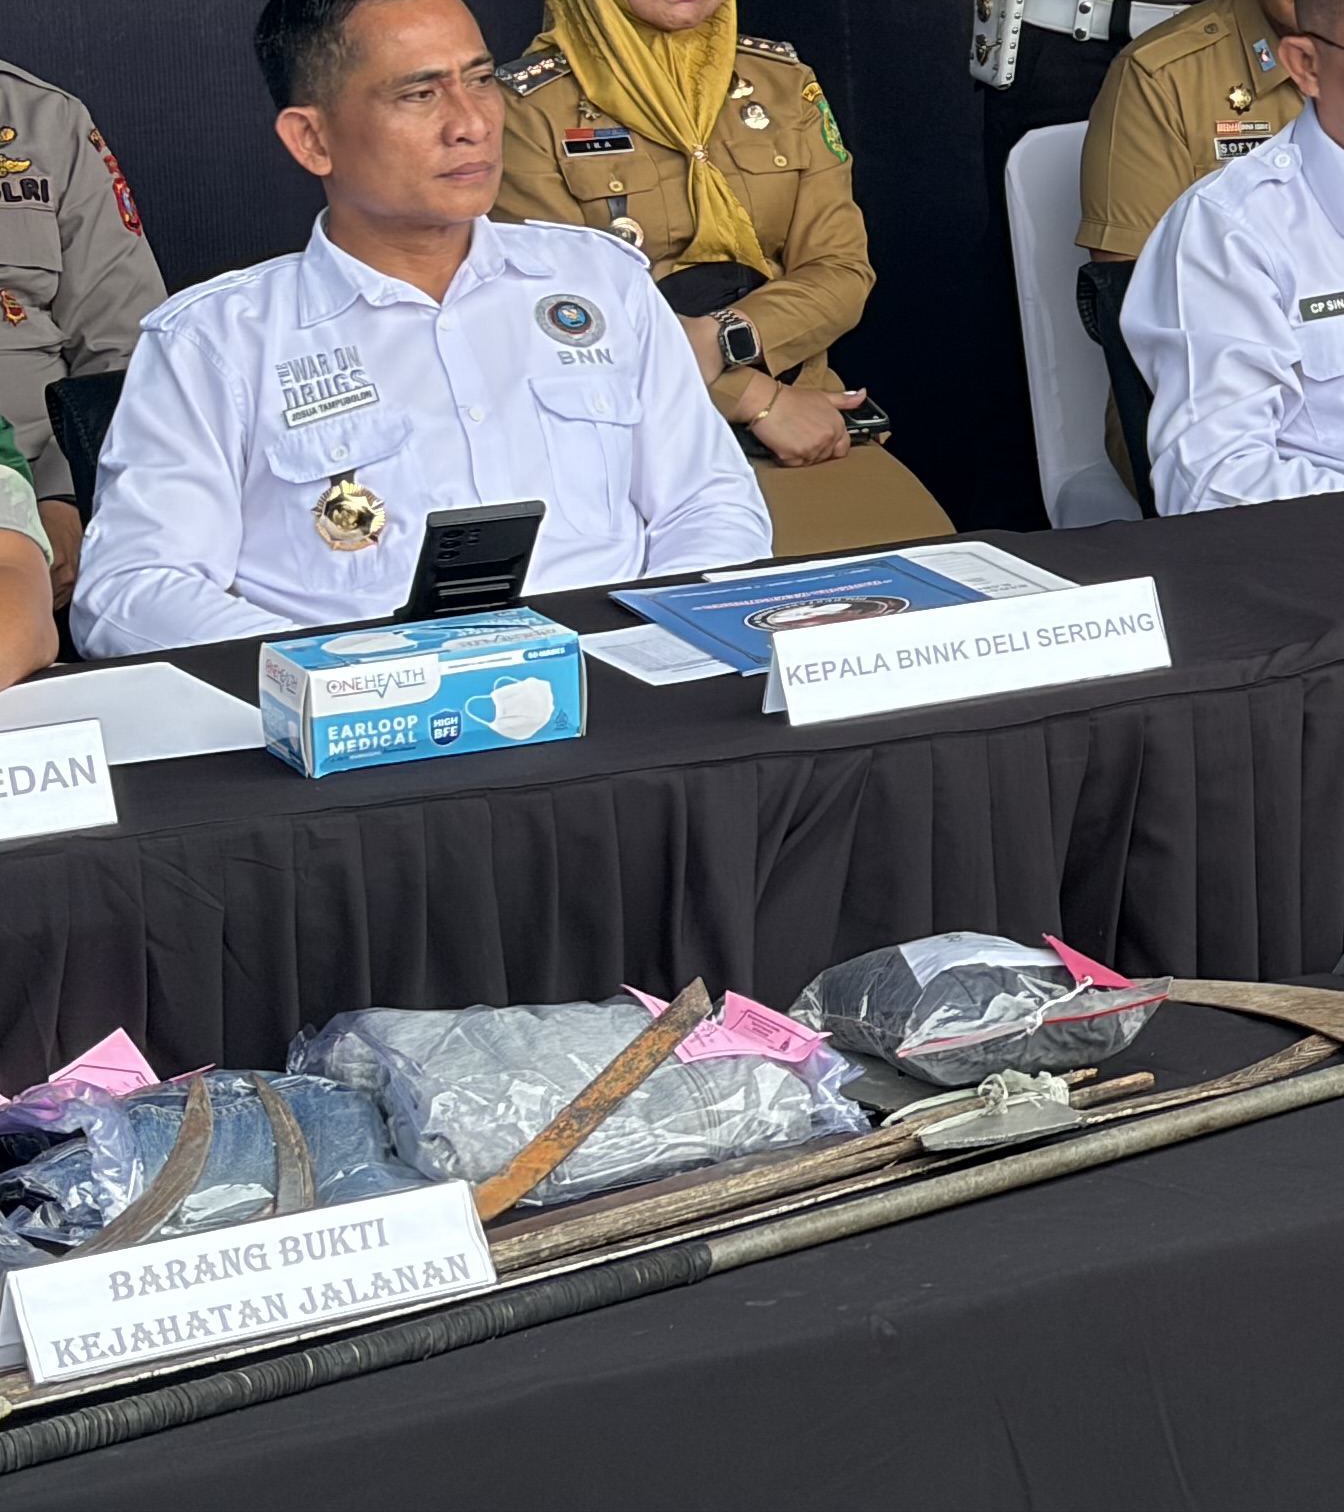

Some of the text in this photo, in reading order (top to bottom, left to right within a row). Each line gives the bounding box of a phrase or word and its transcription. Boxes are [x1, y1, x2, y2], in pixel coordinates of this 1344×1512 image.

[0, 177, 50, 204] LRI
[1309, 302, 1325, 314] CP
[287, 353, 333, 383] WAR
[333, 346, 363, 372] ON
[556, 348, 615, 365] BNN
[291, 389, 373, 422] JOSUA TAMPUBOLON
[786, 612, 1155, 687] KEPALA BNNK DELI SERDANG
[326, 667, 426, 697] ONEHEALTH
[327, 714, 419, 741] EARLOOP
[432, 716, 459, 728] HIGH
[433, 725, 459, 740] BFE
[328, 731, 418, 757] MEDICAL
[108, 1217, 390, 1303] BARANG BUKTI
[50, 1253, 472, 1369] KEJAHATAN JALANAN
